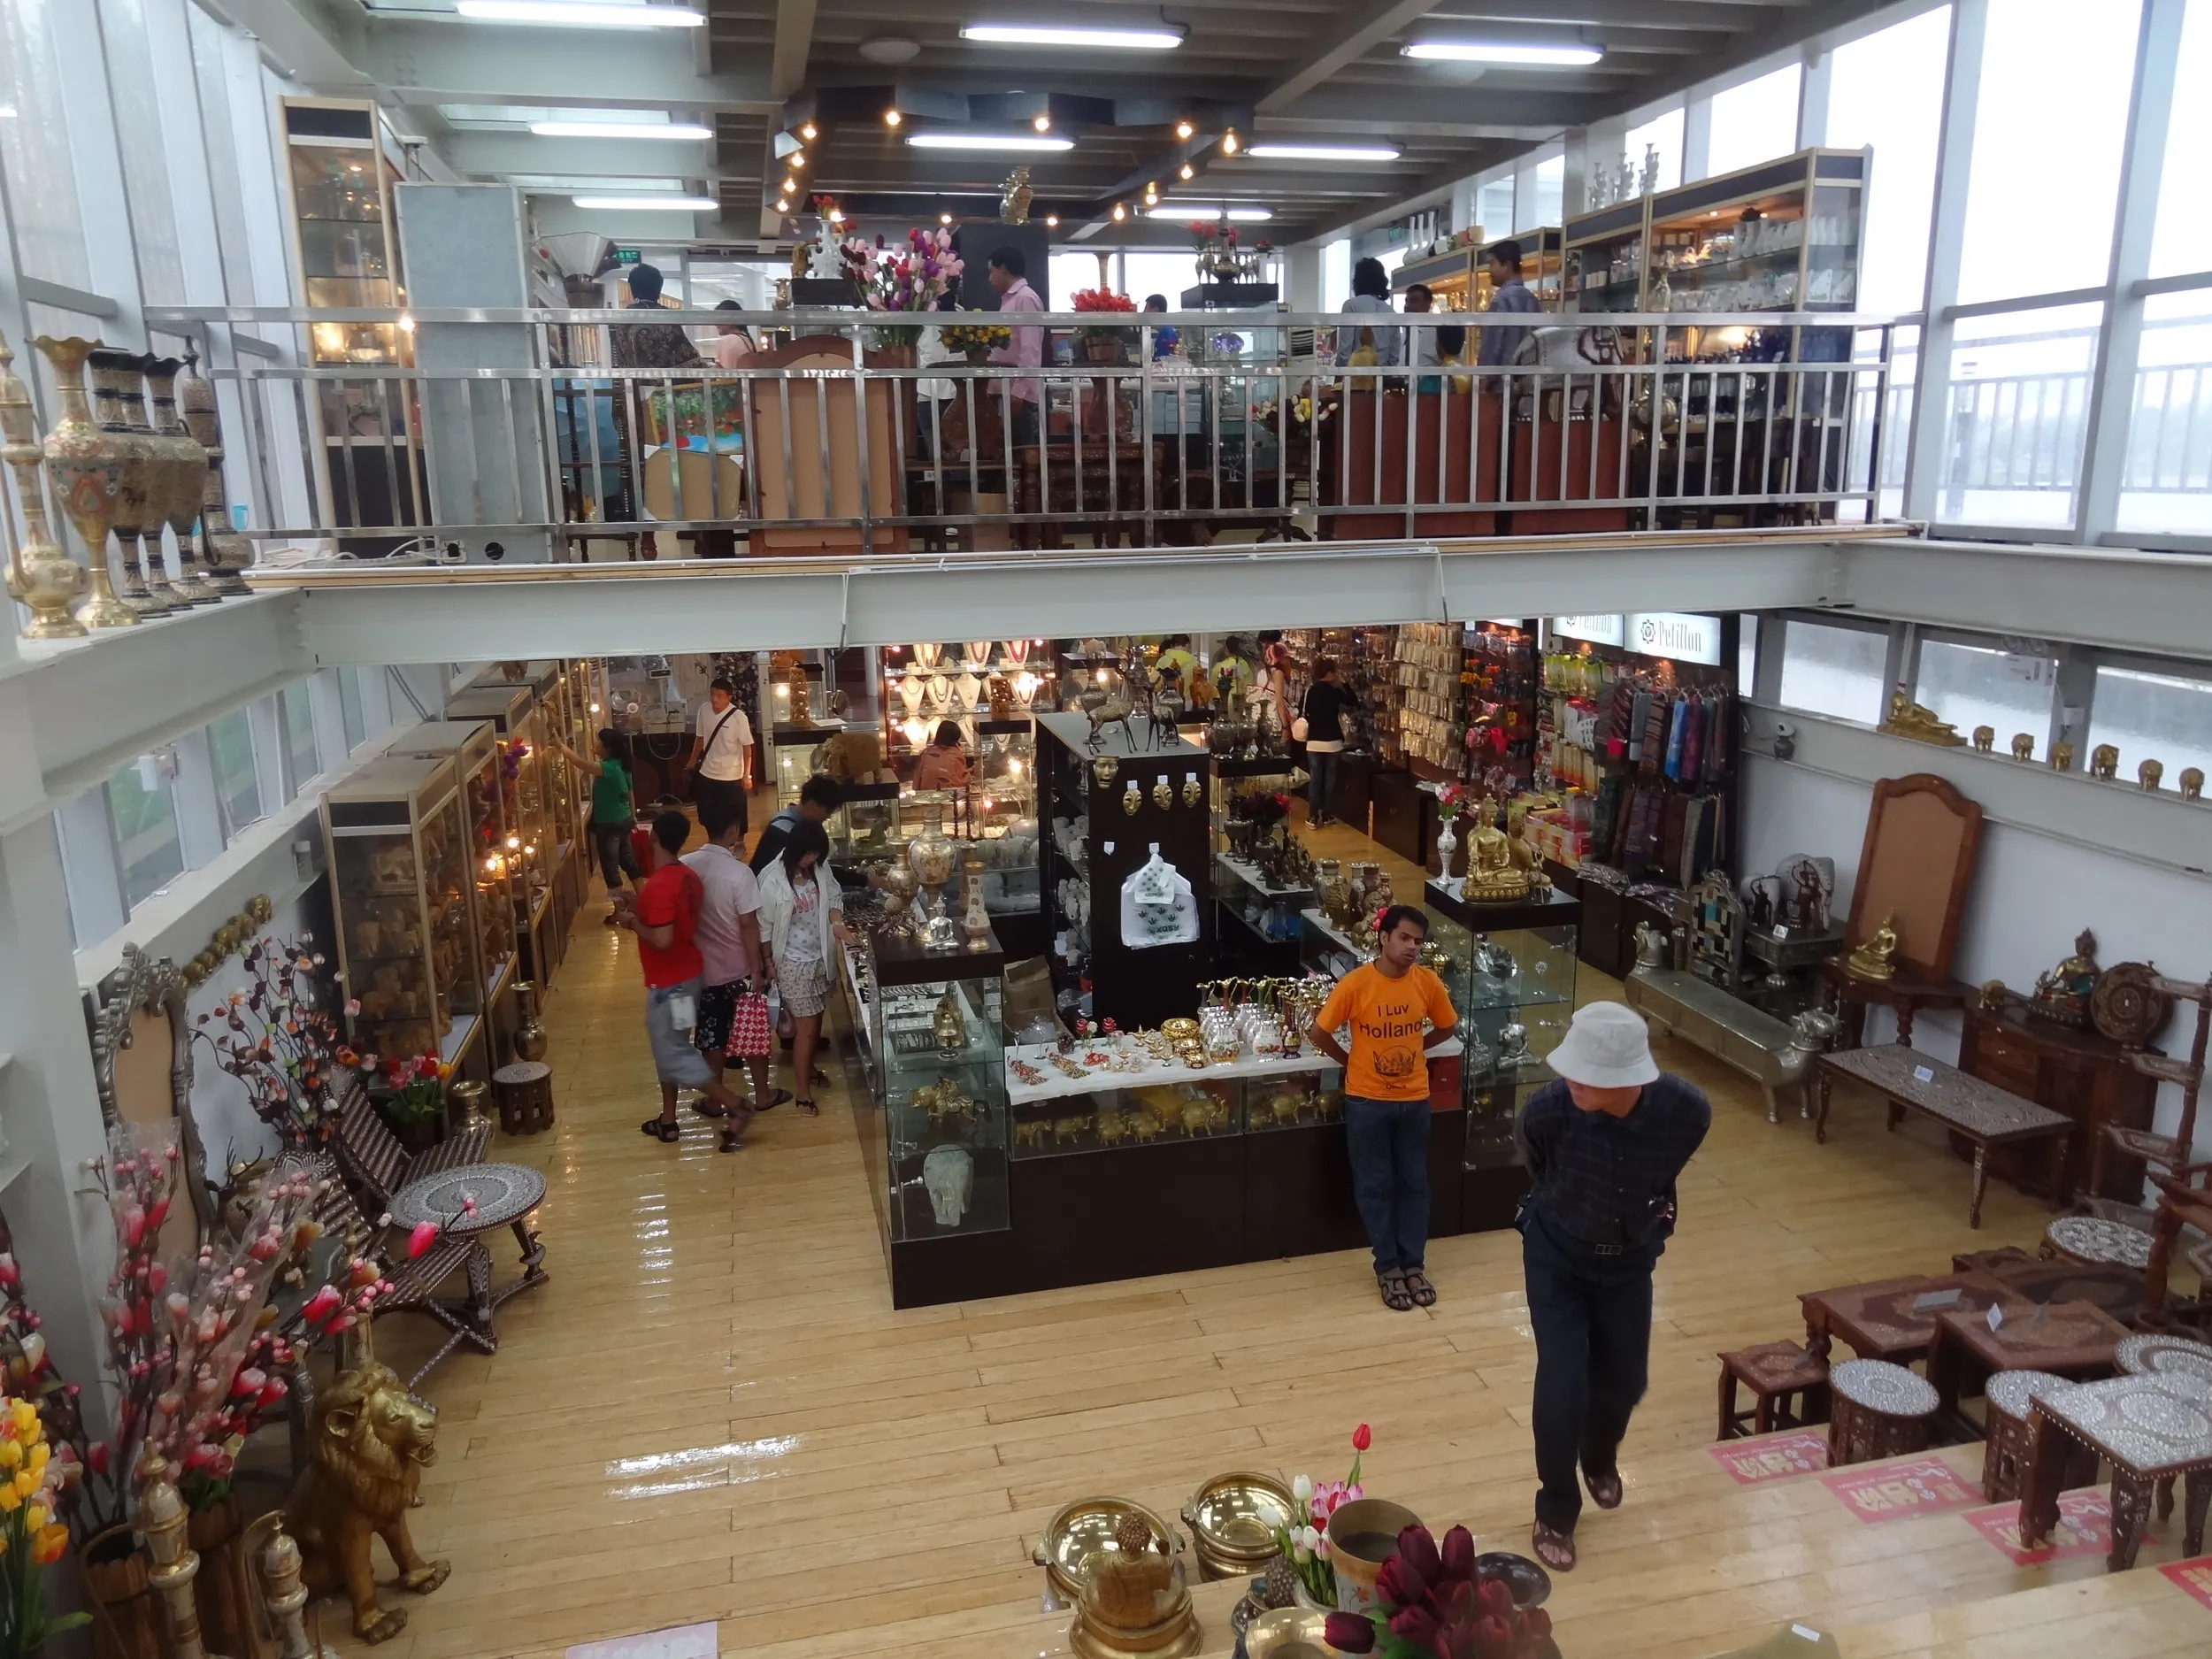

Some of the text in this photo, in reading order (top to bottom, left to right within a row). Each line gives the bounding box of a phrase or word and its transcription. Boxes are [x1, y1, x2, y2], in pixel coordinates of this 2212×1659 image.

[1659, 620, 1701, 653] Petillon
[1377, 1004, 1409, 1018] I Luv
[1358, 1020, 1423, 1039] Holland
